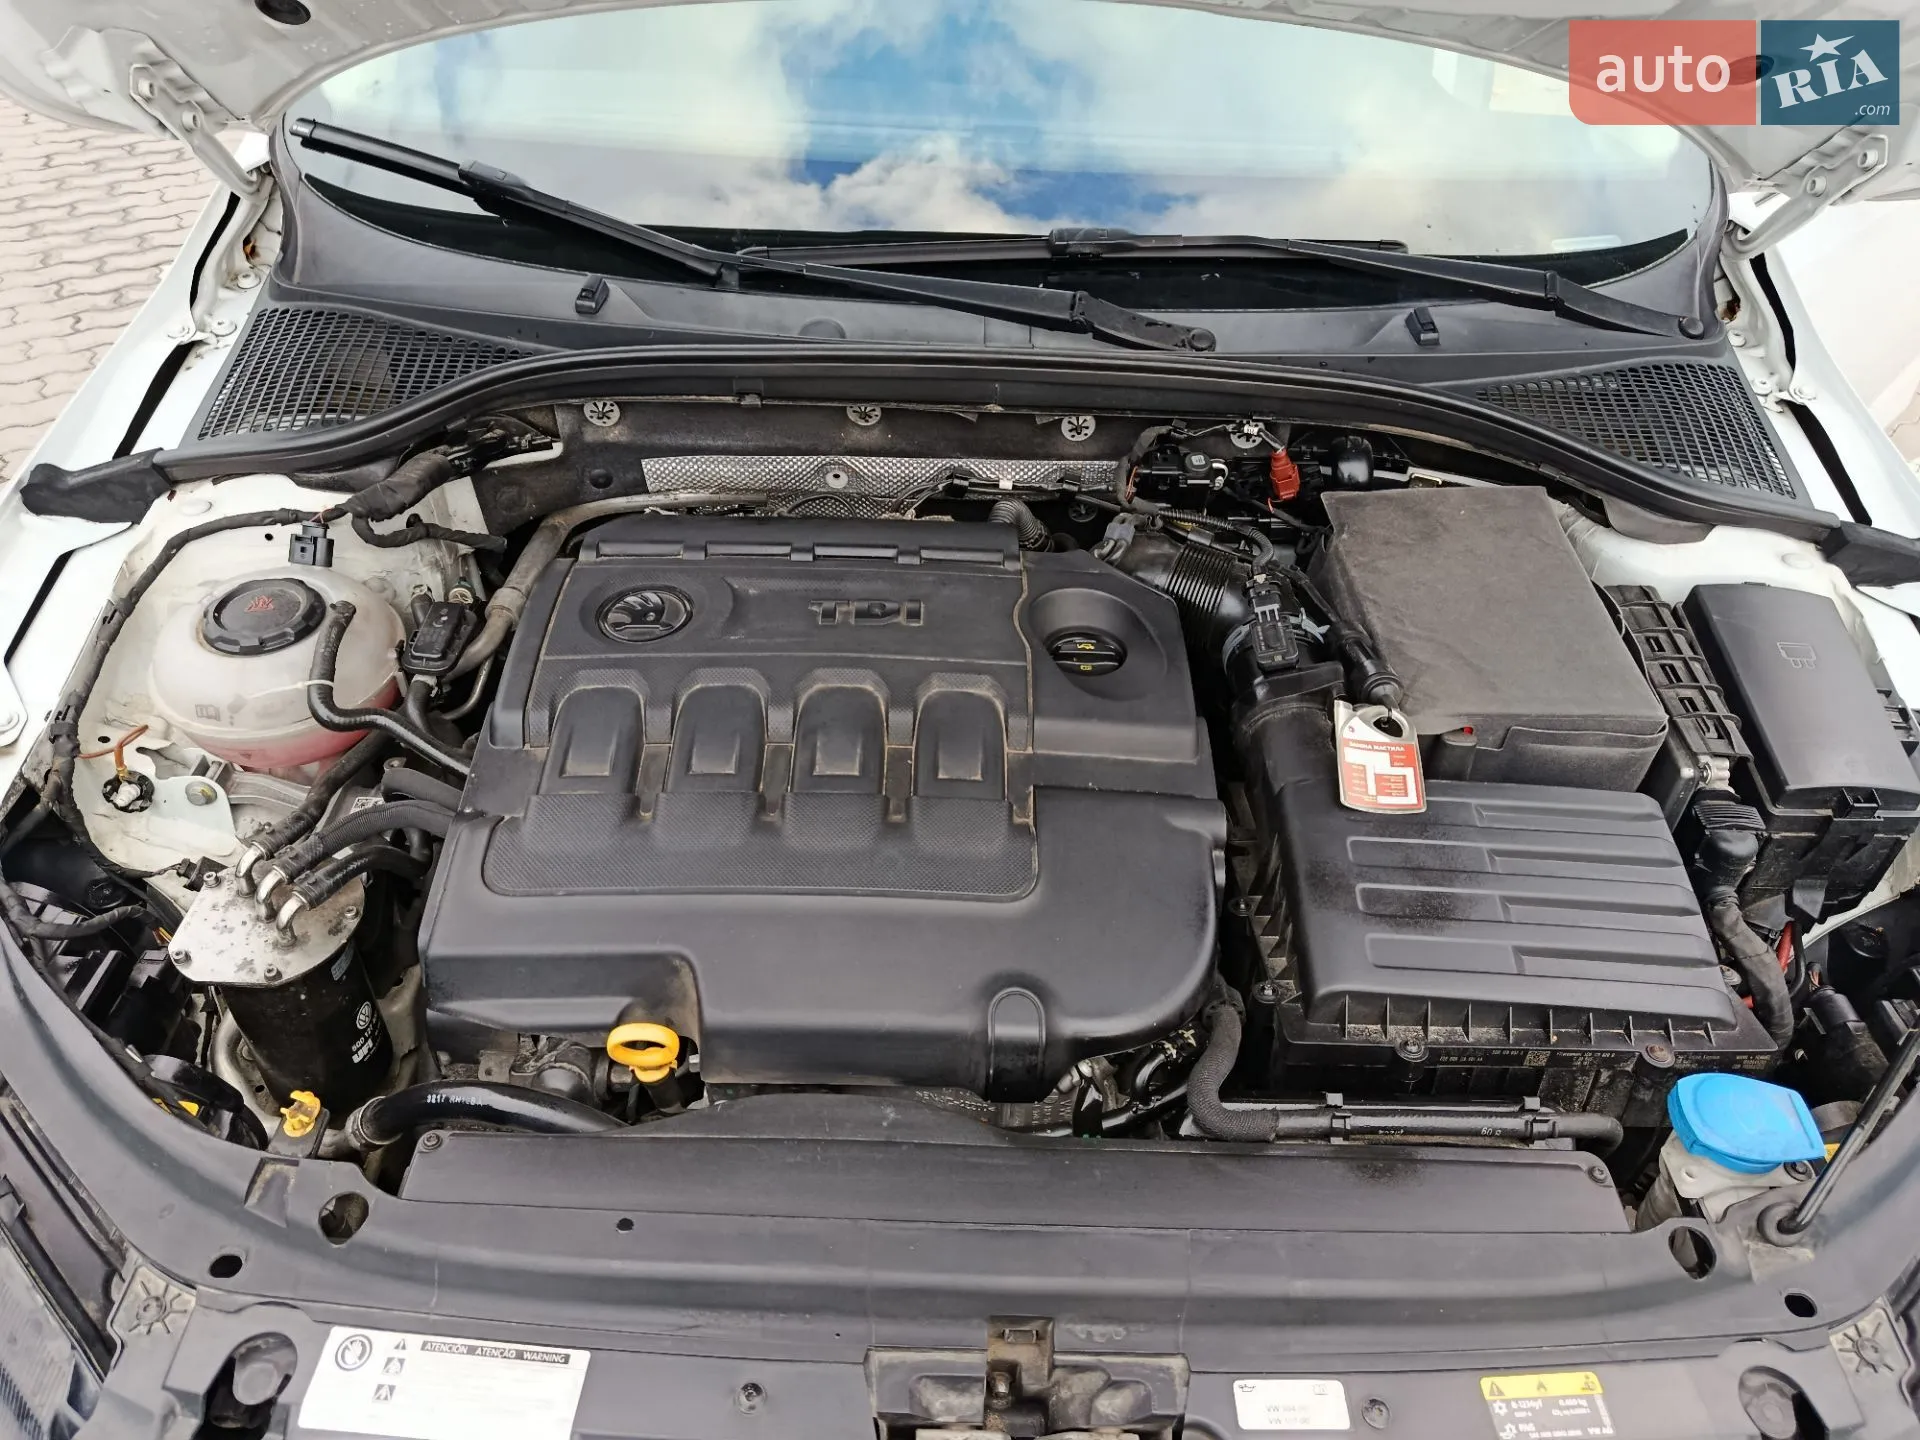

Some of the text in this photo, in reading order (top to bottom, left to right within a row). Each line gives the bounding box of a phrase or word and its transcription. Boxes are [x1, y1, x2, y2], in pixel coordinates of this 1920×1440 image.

[808, 600, 924, 626] TDI
[423, 1341, 566, 1363] ATENCIÓN ATENÇÃO WARNING
